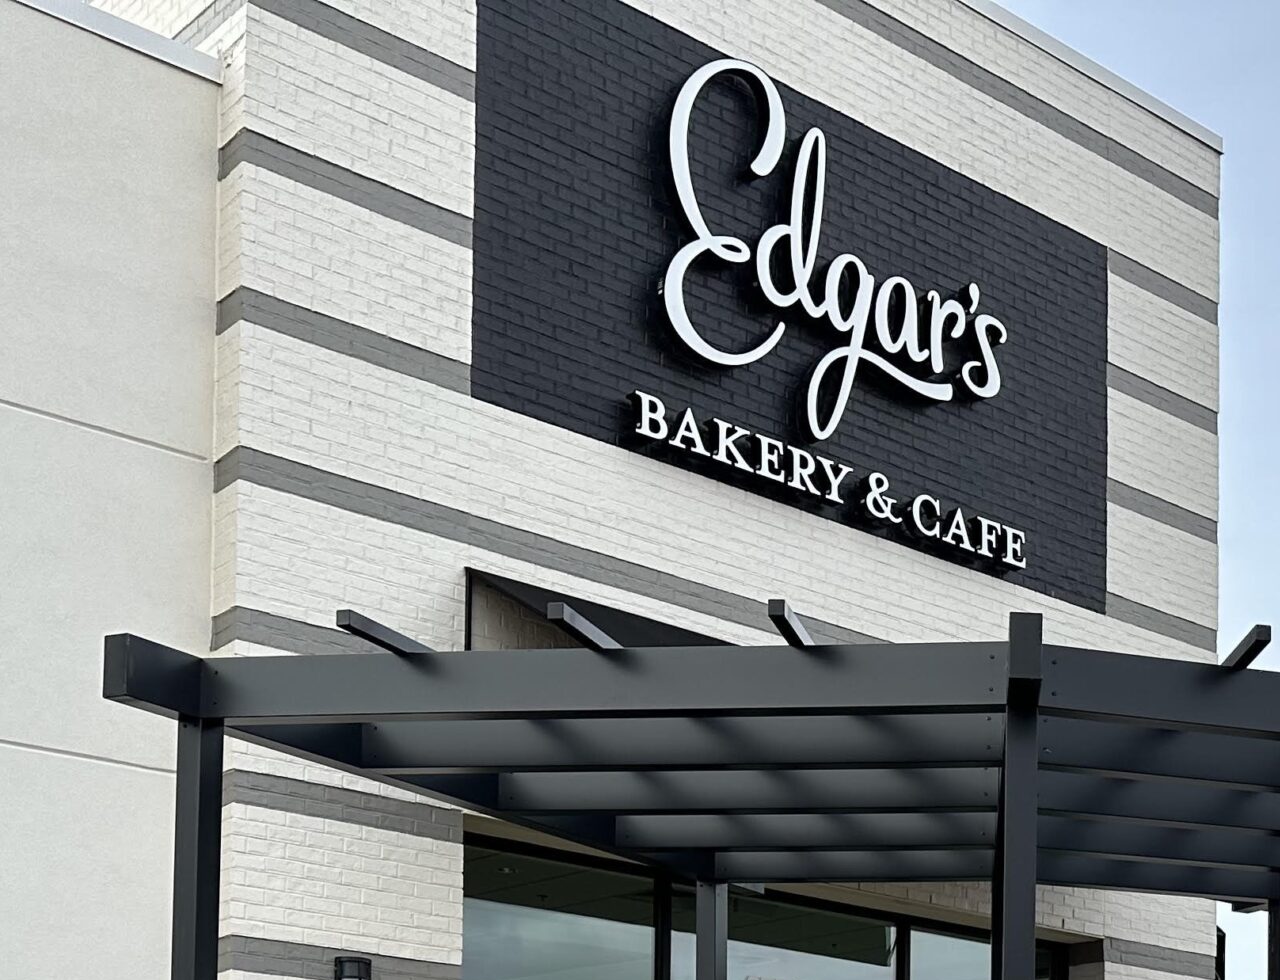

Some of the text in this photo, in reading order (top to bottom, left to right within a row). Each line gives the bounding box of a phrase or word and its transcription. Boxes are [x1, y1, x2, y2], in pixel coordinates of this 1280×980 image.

[664, 58, 1008, 440] Edgar's
[634, 390, 1027, 569] BAKERY & CAFE
